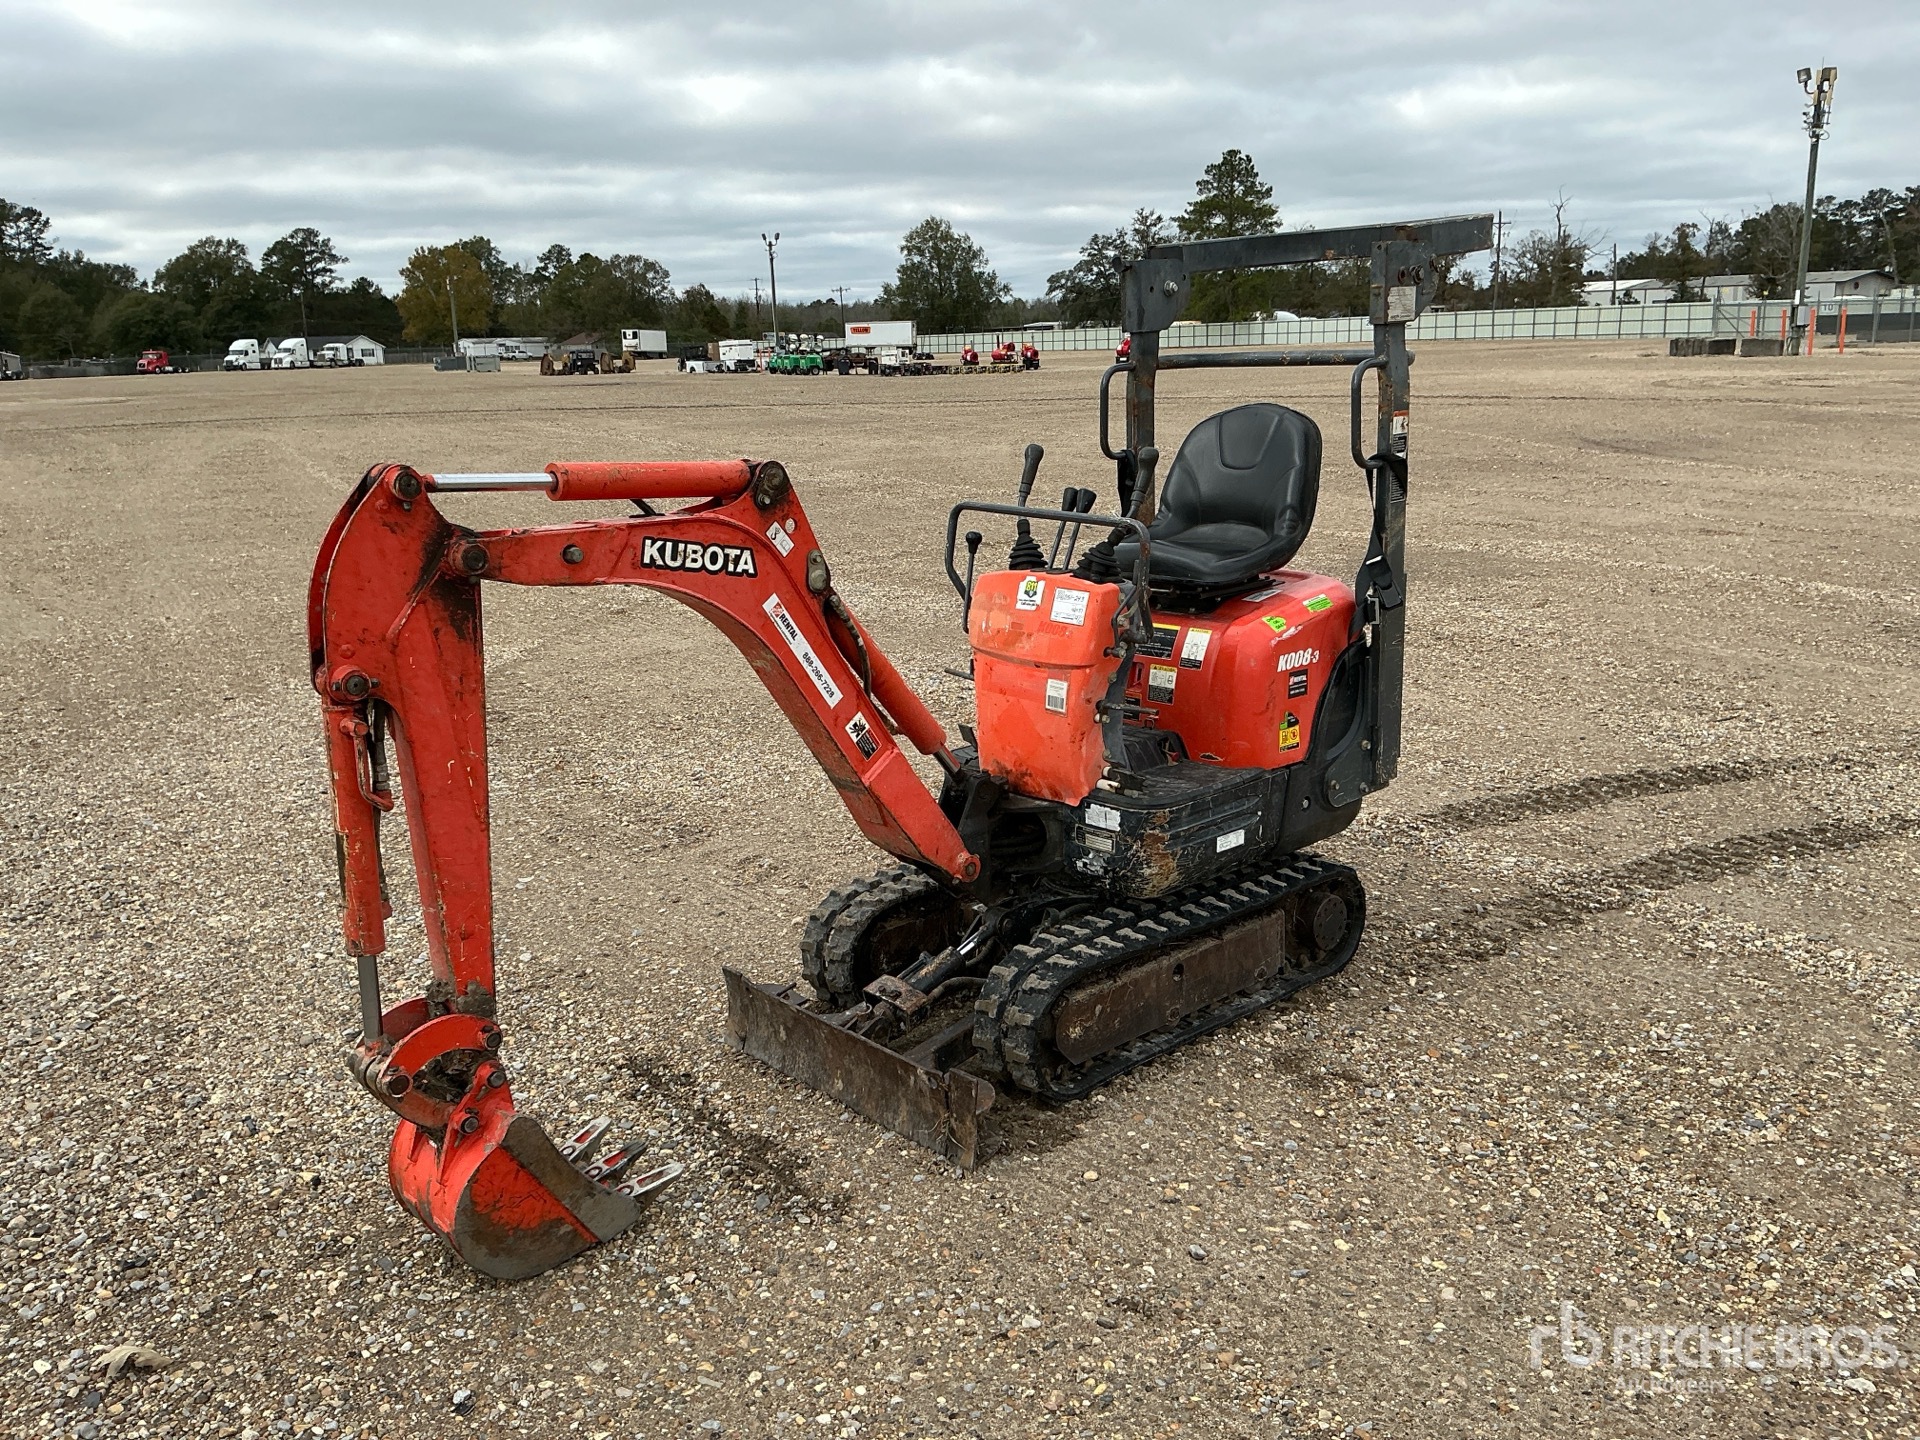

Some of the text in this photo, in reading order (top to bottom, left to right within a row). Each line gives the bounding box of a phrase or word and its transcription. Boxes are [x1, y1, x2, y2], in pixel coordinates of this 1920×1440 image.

[643, 539, 755, 574] KUBOTA
[779, 613, 798, 641] RENTAL
[802, 651, 835, 699] 888-266-7228
[1277, 647, 1320, 672] K008-3
